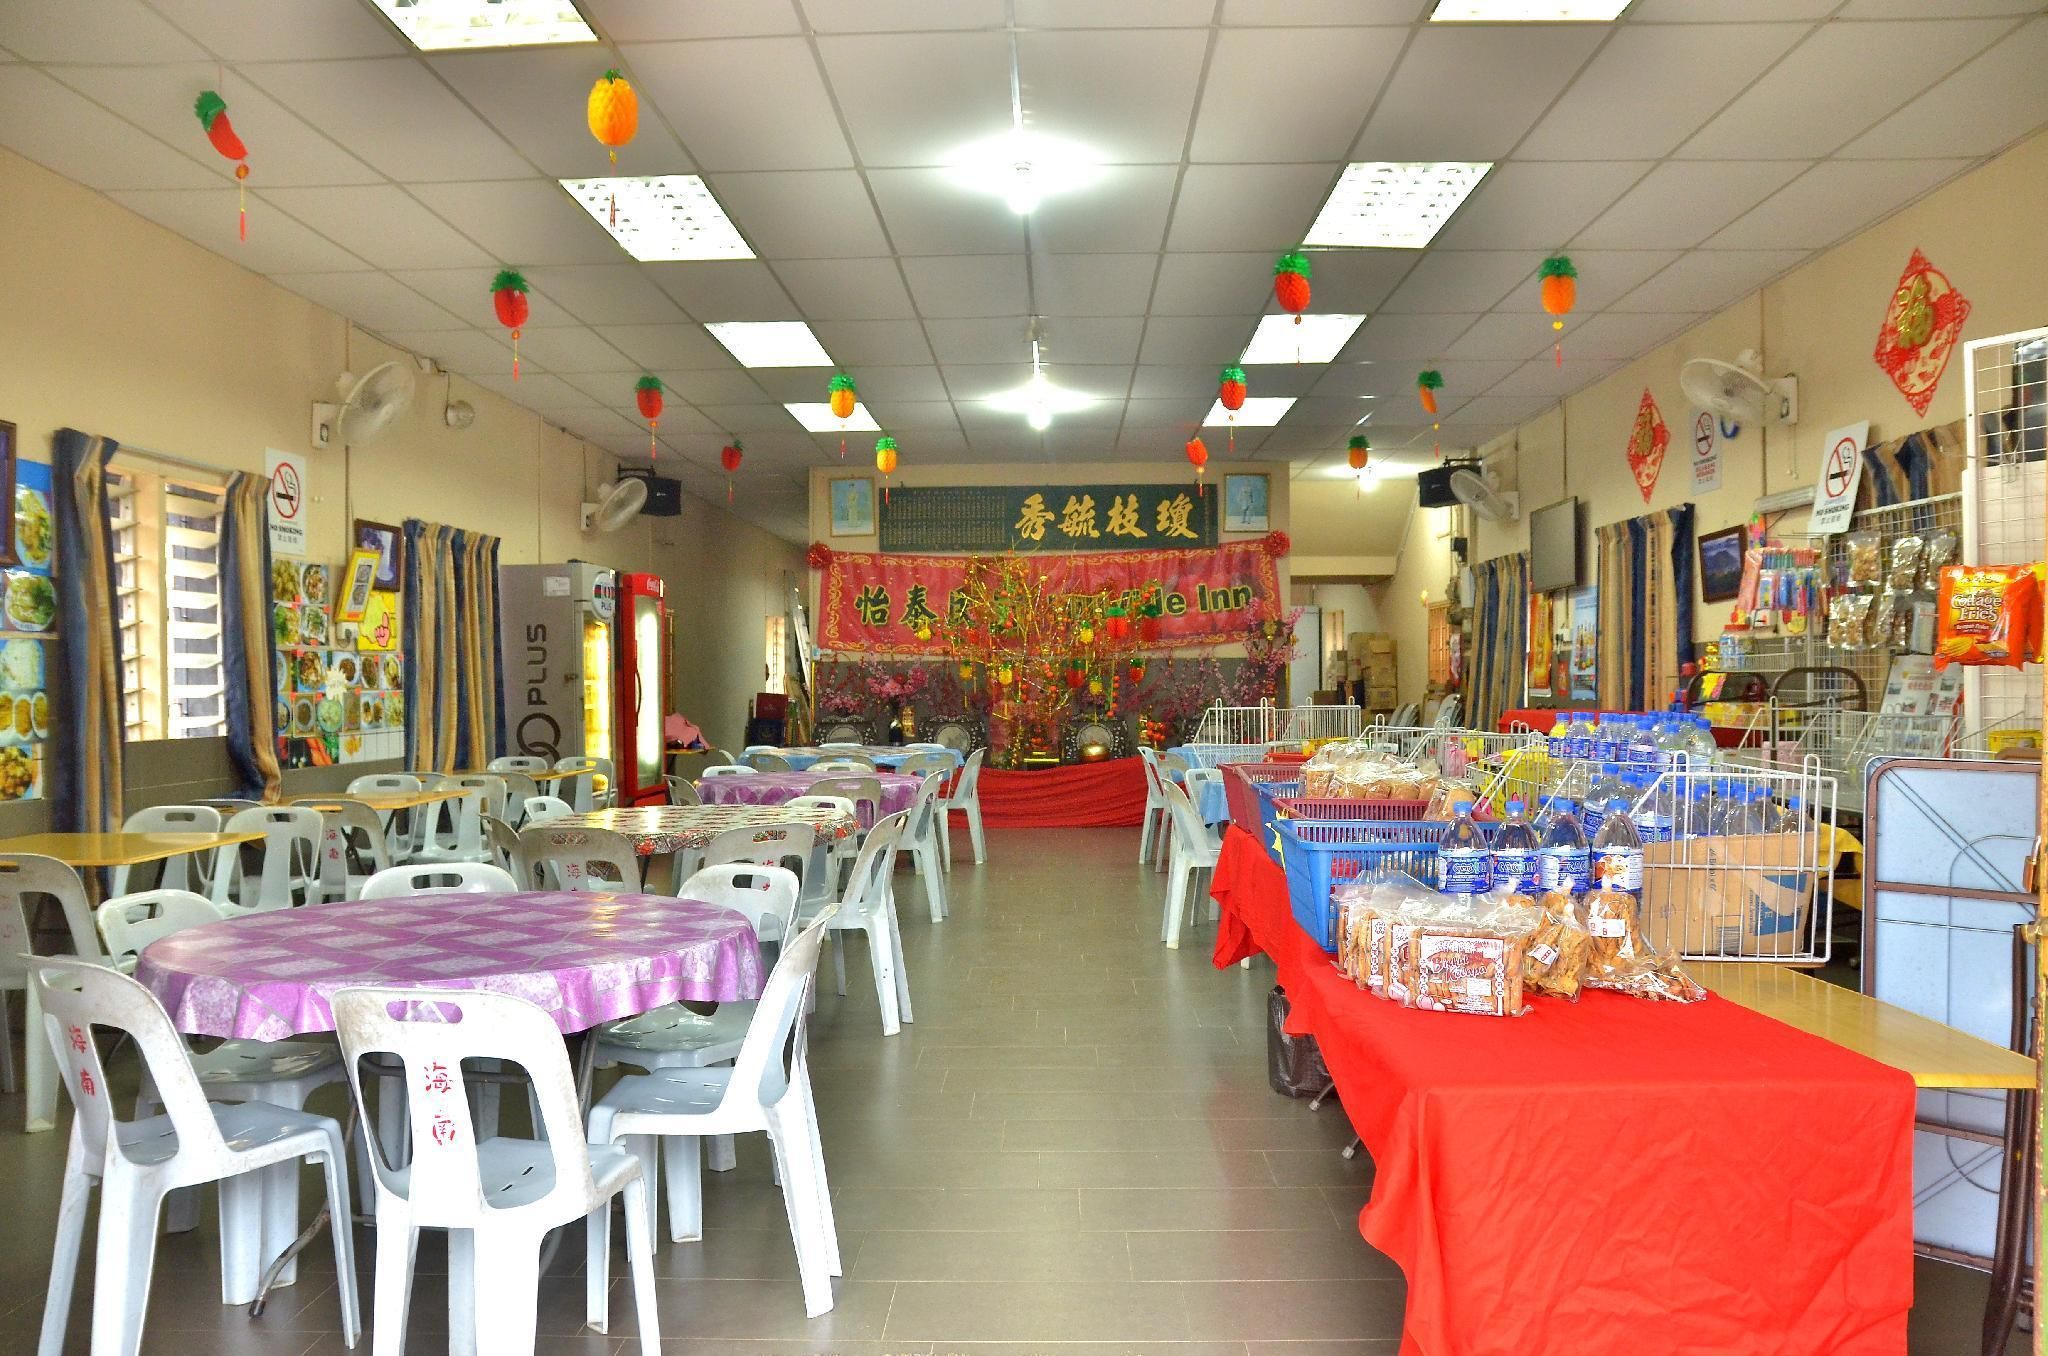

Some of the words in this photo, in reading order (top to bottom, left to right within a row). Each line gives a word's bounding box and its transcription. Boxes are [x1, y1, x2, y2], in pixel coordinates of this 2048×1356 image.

[1197, 583, 1252, 613] Inn
[1958, 606, 1998, 622] Fries
[526, 623, 548, 706] PLUS
[423, 1061, 456, 1146] 海南
